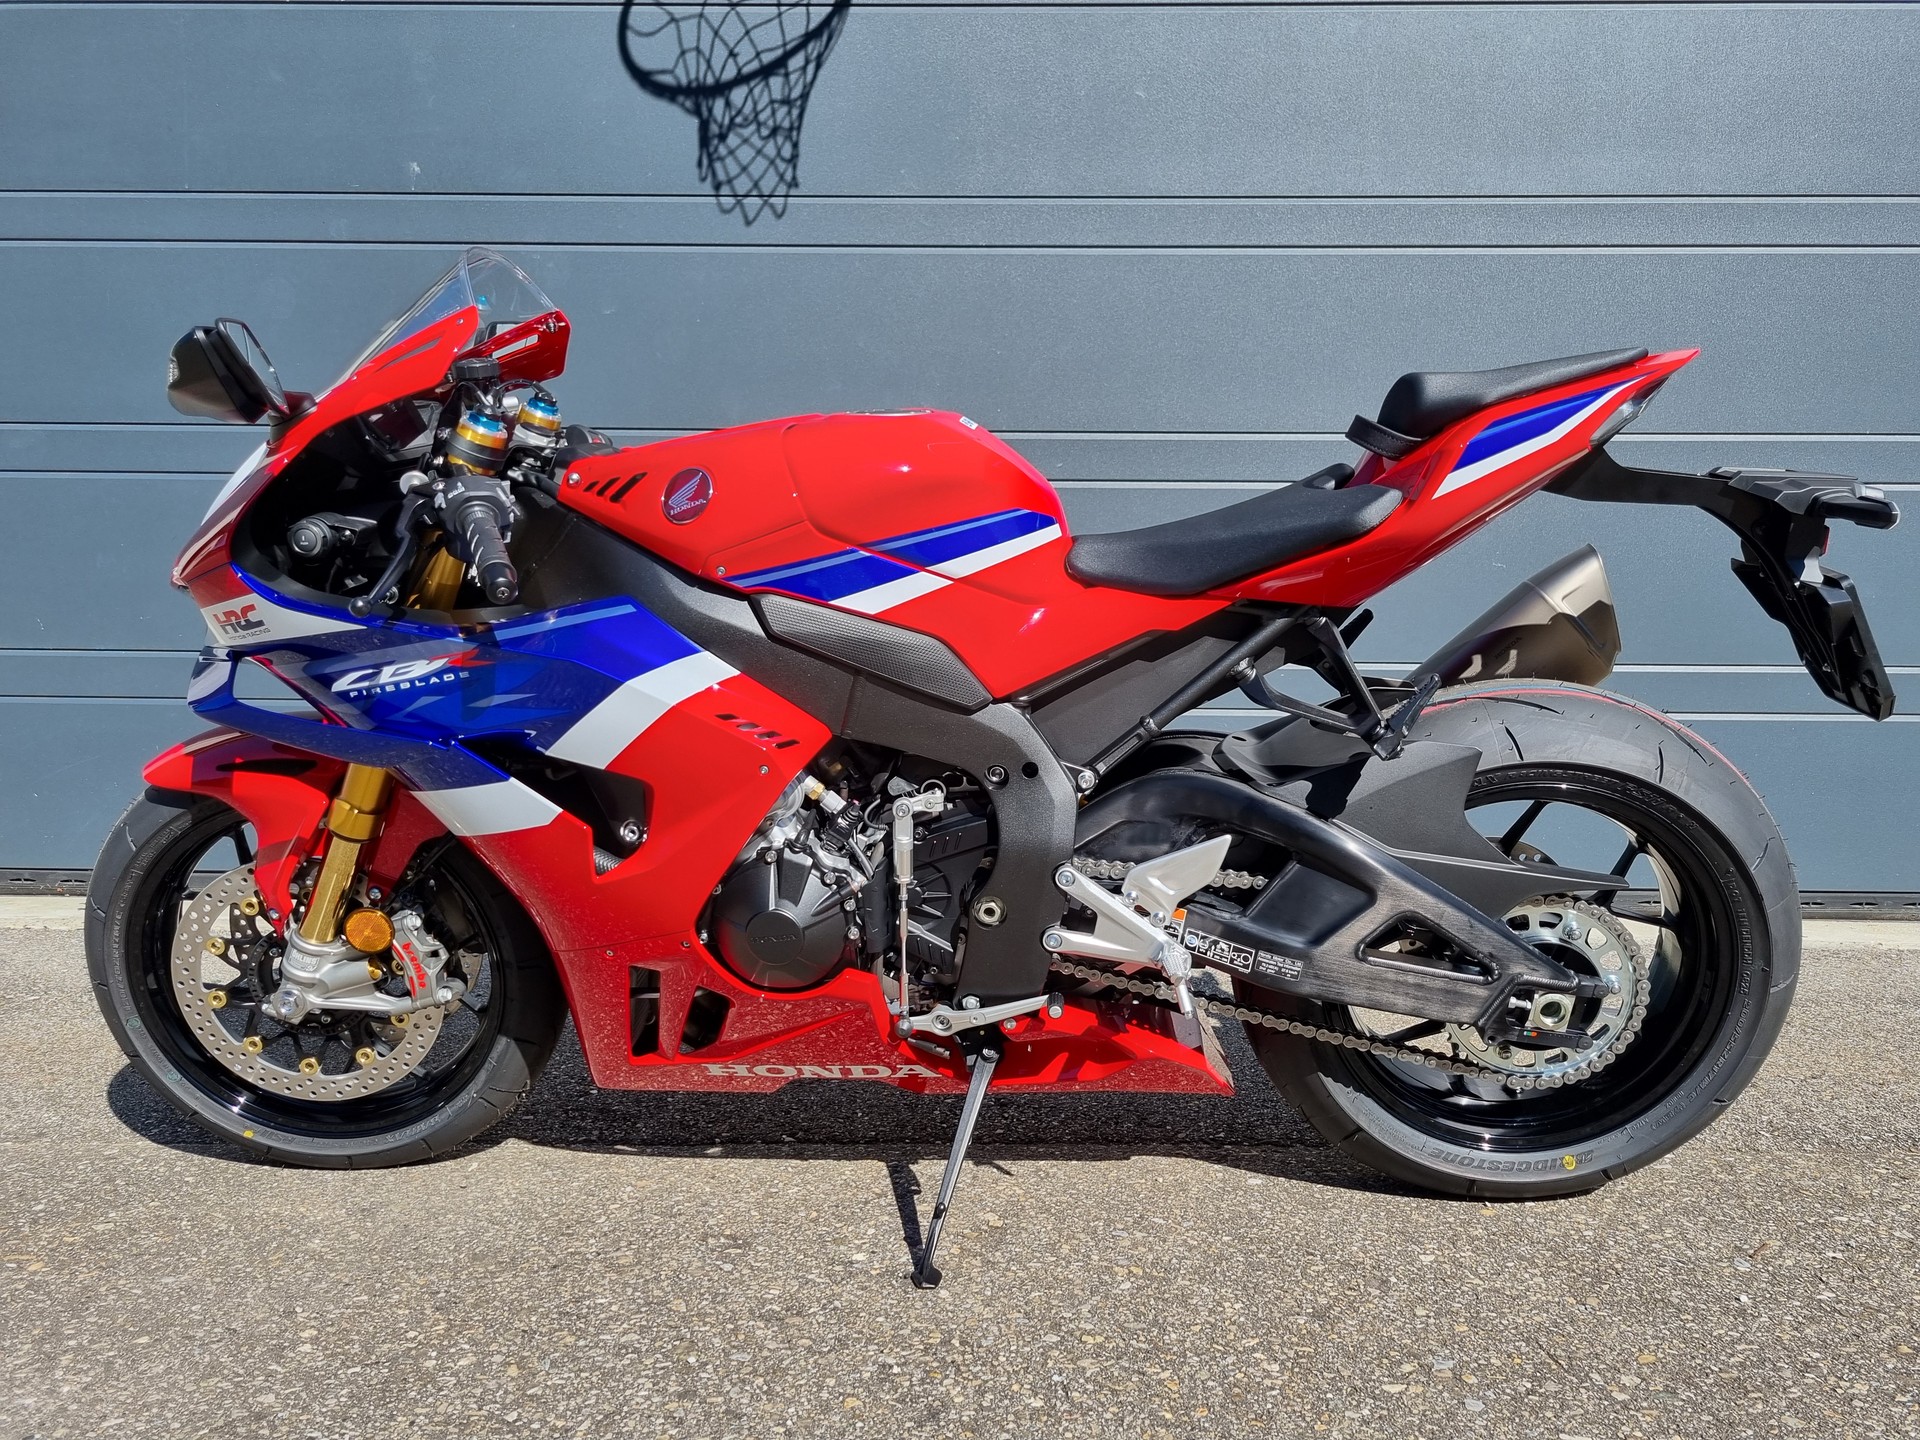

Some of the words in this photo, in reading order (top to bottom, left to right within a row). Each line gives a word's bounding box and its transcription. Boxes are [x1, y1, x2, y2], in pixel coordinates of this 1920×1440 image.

[670, 498, 707, 516] HONDA
[212, 603, 266, 635] HRC
[349, 671, 471, 699] FIREBLADE
[402, 941, 428, 989] brembo
[701, 1063, 943, 1079] HONDA
[1427, 1146, 1595, 1173] BRIDGESTONE
